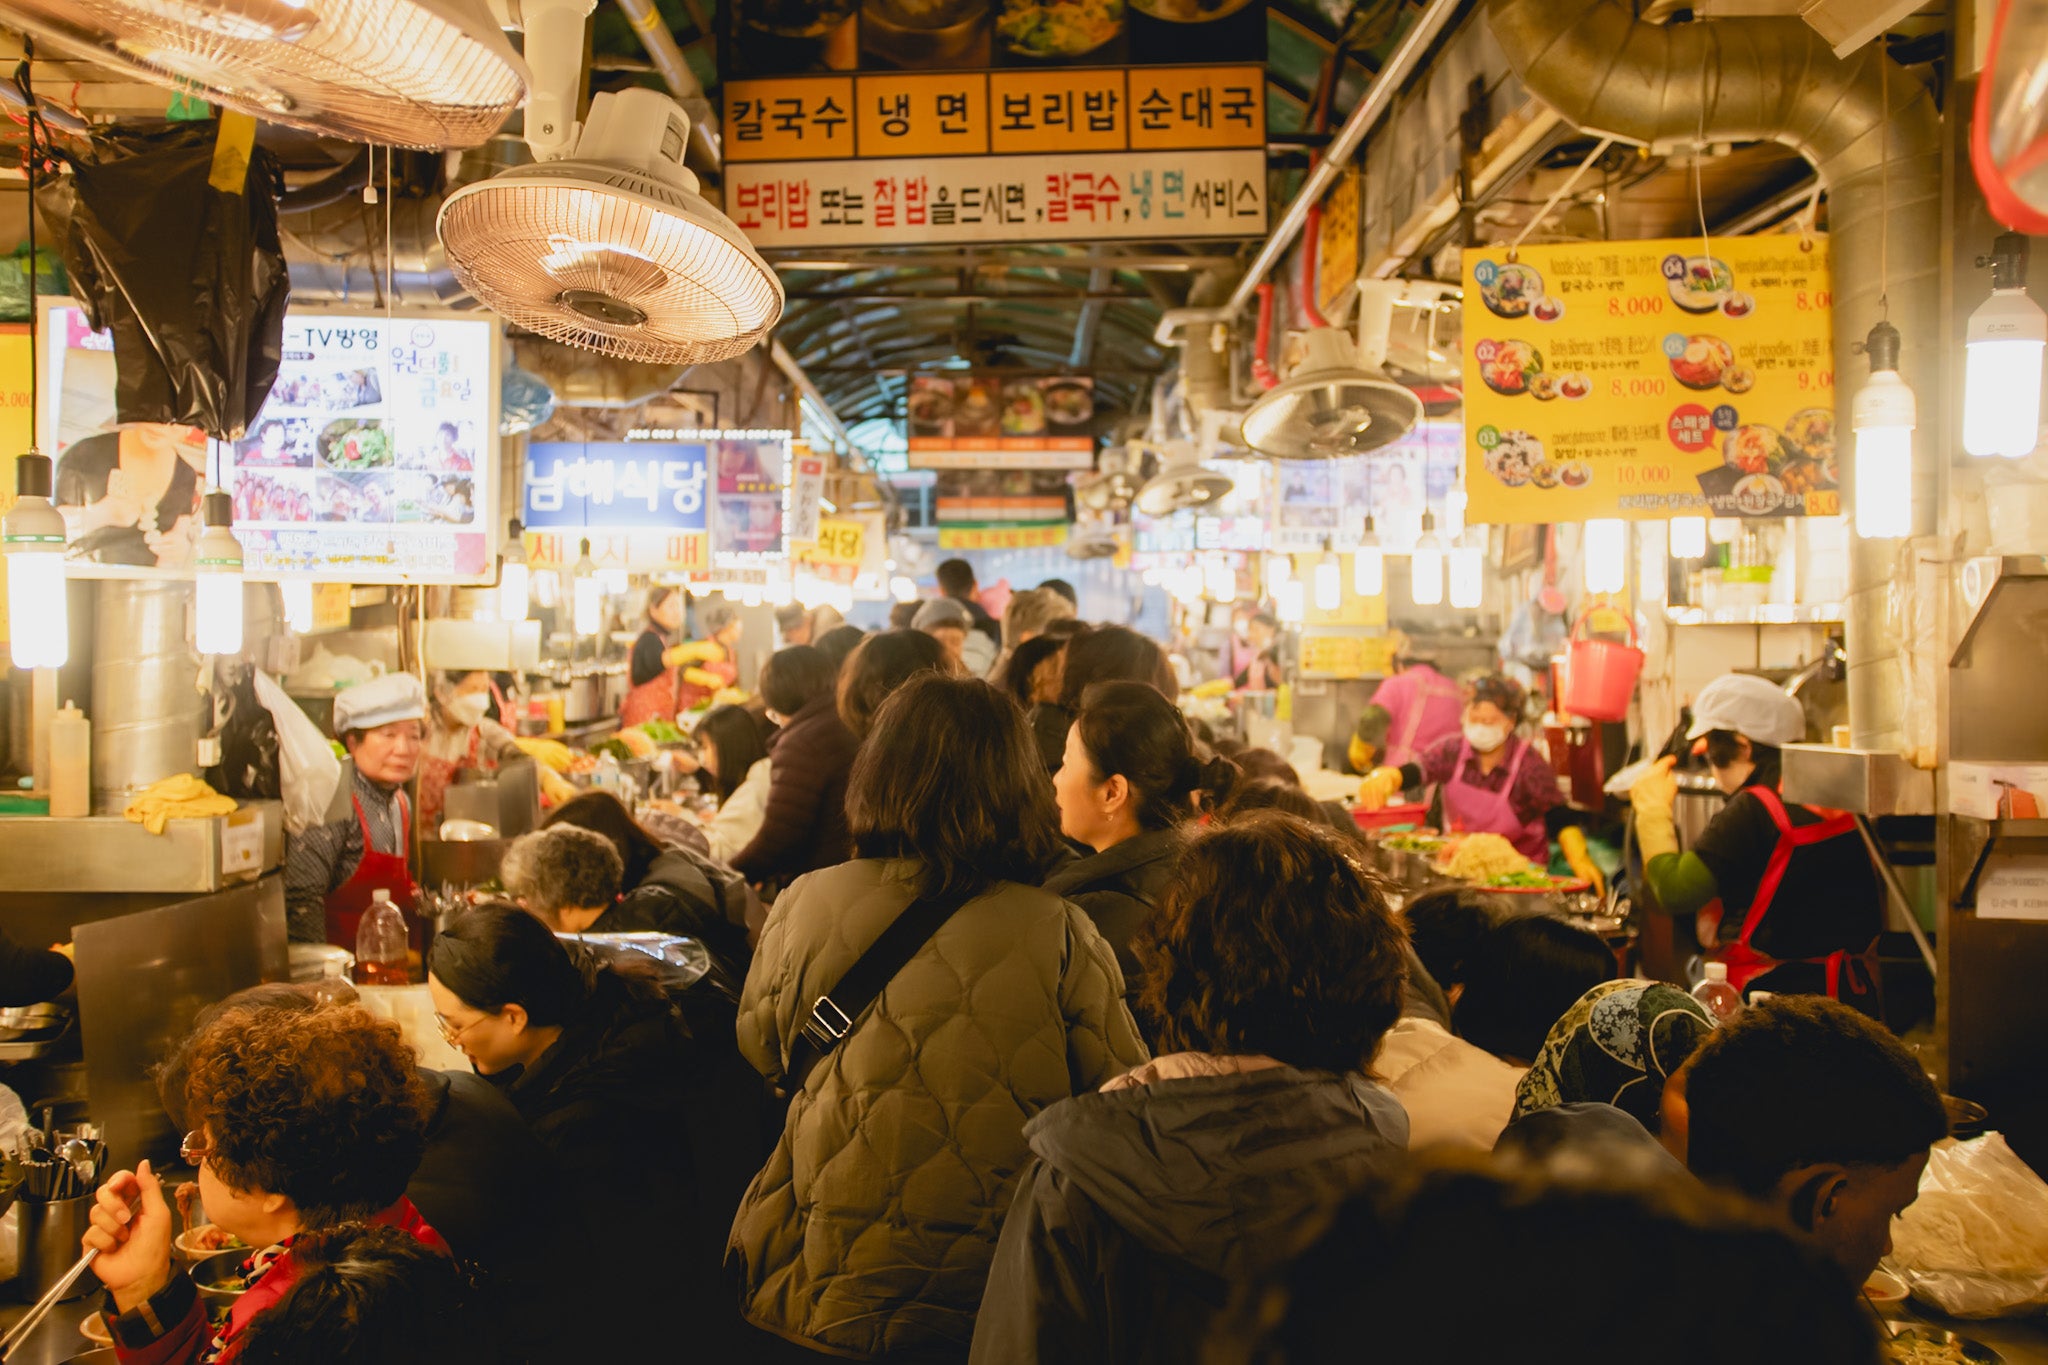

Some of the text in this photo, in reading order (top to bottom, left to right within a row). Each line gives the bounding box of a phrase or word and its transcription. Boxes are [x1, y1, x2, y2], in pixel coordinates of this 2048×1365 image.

[732, 97, 847, 141] 칼국수
[1000, 90, 1119, 133] 보리밥
[1138, 87, 1256, 129] 순대국
[737, 178, 811, 230] 보리밥
[820, 187, 864, 226] 또는
[1677, 428, 1704, 444] 세트
[526, 456, 707, 514] 남해식당
